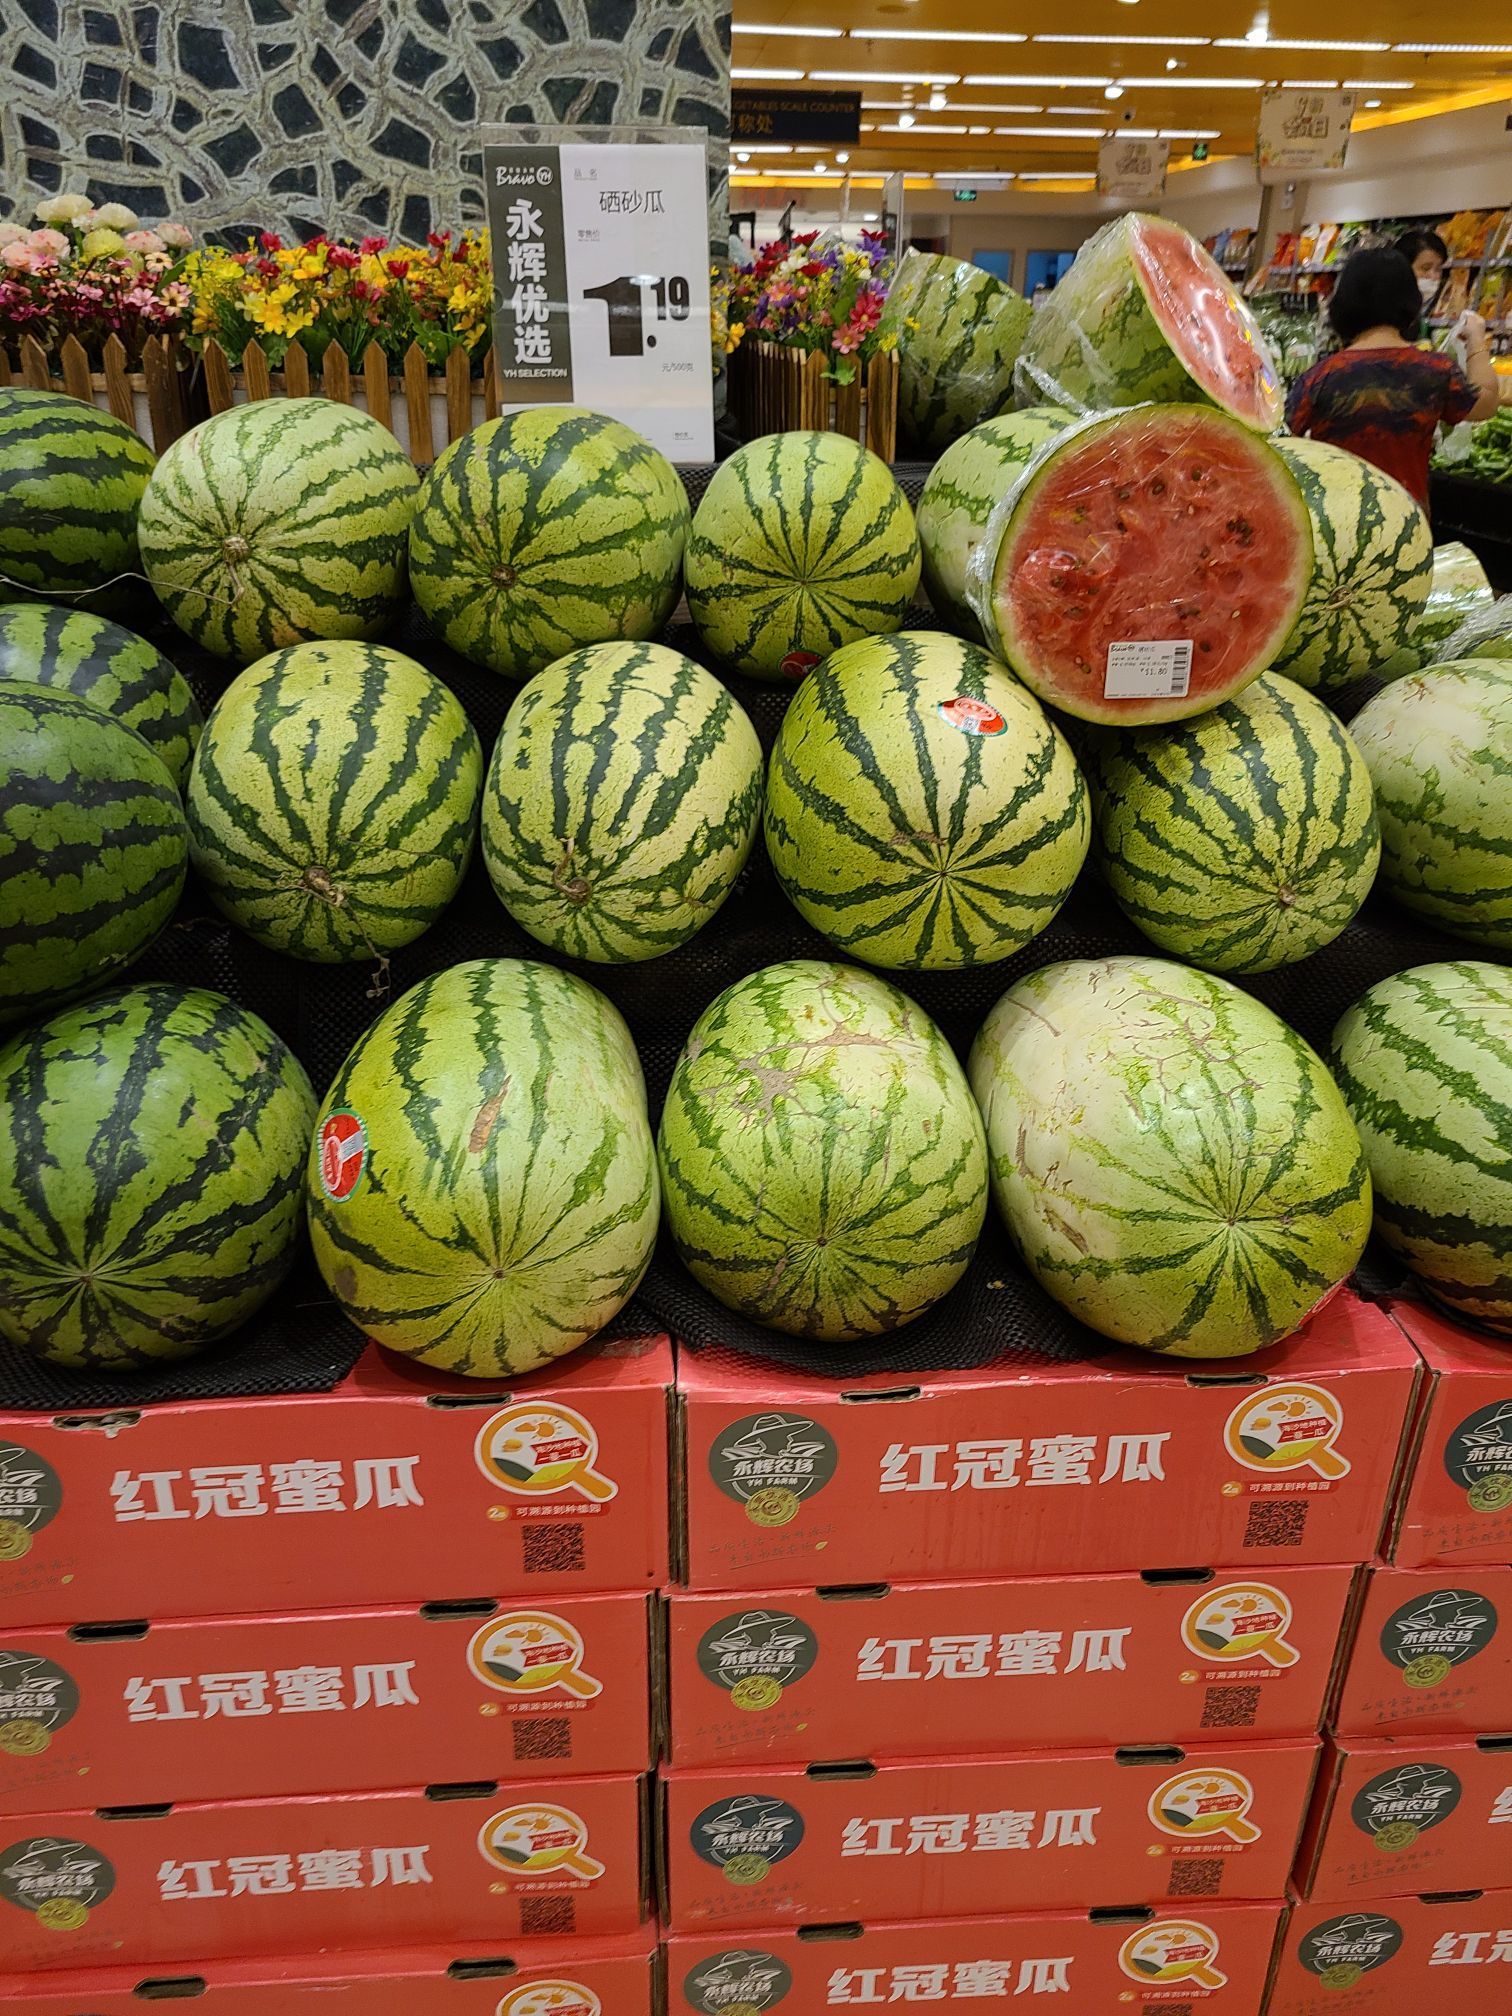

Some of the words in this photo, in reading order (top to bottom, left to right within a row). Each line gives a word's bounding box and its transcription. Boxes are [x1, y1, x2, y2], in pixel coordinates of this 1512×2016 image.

[496, 166, 536, 186] Bravo
[599, 189, 665, 214] 硒砂瓜
[505, 198, 552, 364] 永辉优选
[503, 368, 517, 378] YH
[518, 368, 567, 378] SELECTION
[733, 1458, 815, 1476] 永辉农场
[879, 1432, 1171, 1492] 红冠蜜瓜
[1476, 1464, 1489, 1473] YH
[110, 1455, 424, 1522] 红冠蜜瓜
[856, 1627, 1132, 1681] 红冠蜜瓜
[1401, 1629, 1474, 1645] 永辉农场
[123, 1660, 420, 1723] 红冠蜜瓜
[1371, 1799, 1440, 1814] 永辉农场
[841, 1807, 1102, 1856] 红冠蜜瓜
[156, 1845, 433, 1900] 红冠蜜瓜
[1317, 1943, 1382, 1957] 永辉农场
[827, 1957, 1074, 2004] 红冠蜜瓜
